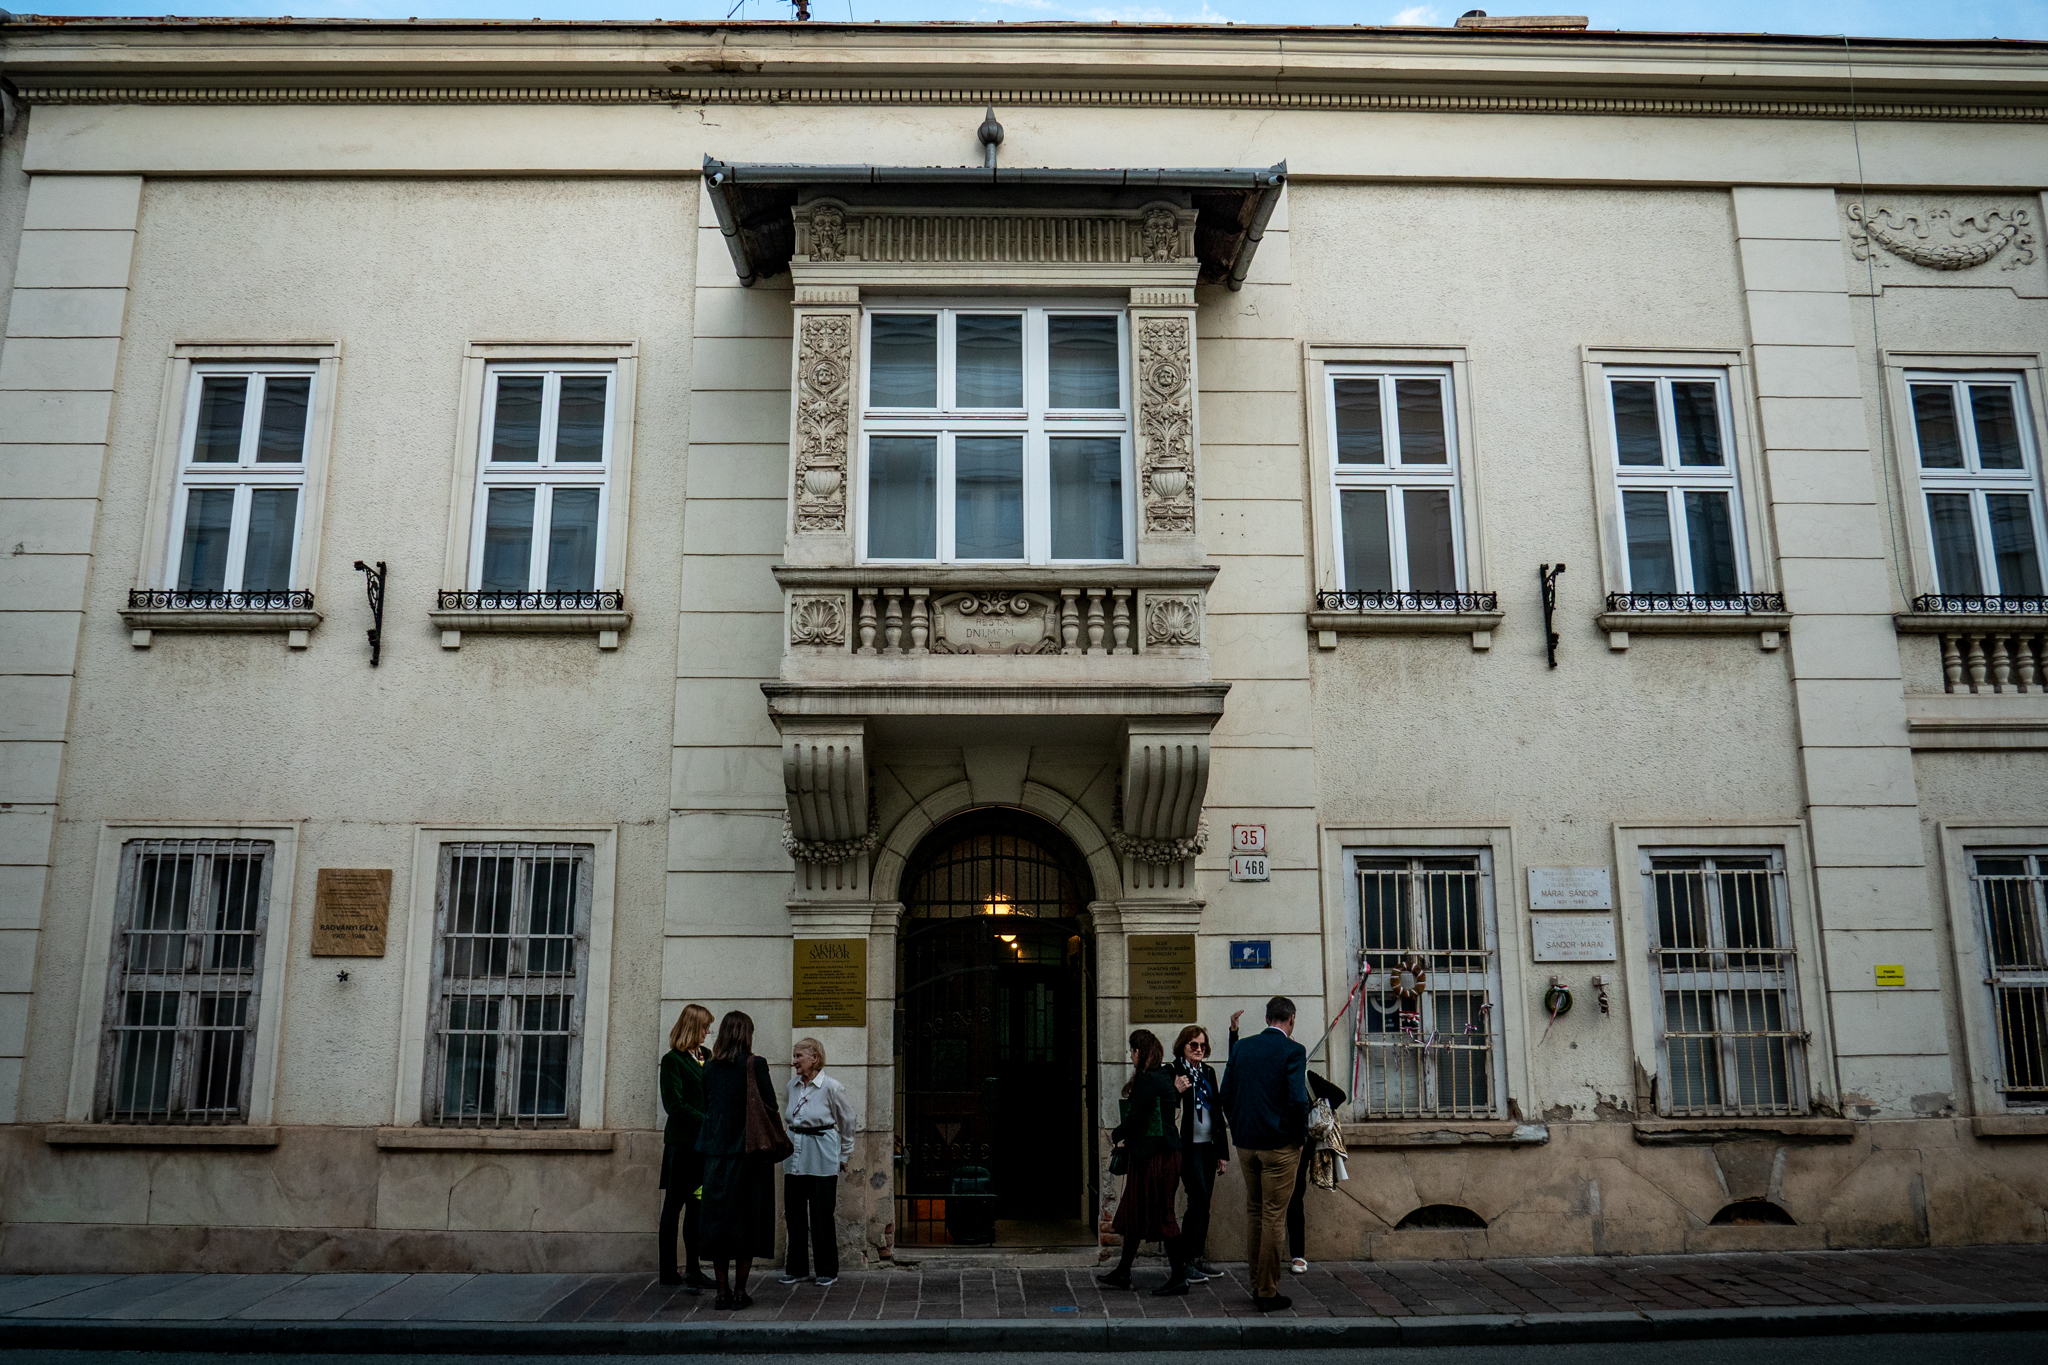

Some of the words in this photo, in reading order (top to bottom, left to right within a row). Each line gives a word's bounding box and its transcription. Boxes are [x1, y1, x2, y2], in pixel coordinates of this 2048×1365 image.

[1241, 830, 1257, 845] 35
[1245, 860, 1264, 874] 468
[1569, 889, 1598, 897] SÁNDOR
[814, 942, 846, 953] MÁRAI
[810, 950, 850, 959] SÁNDOR
